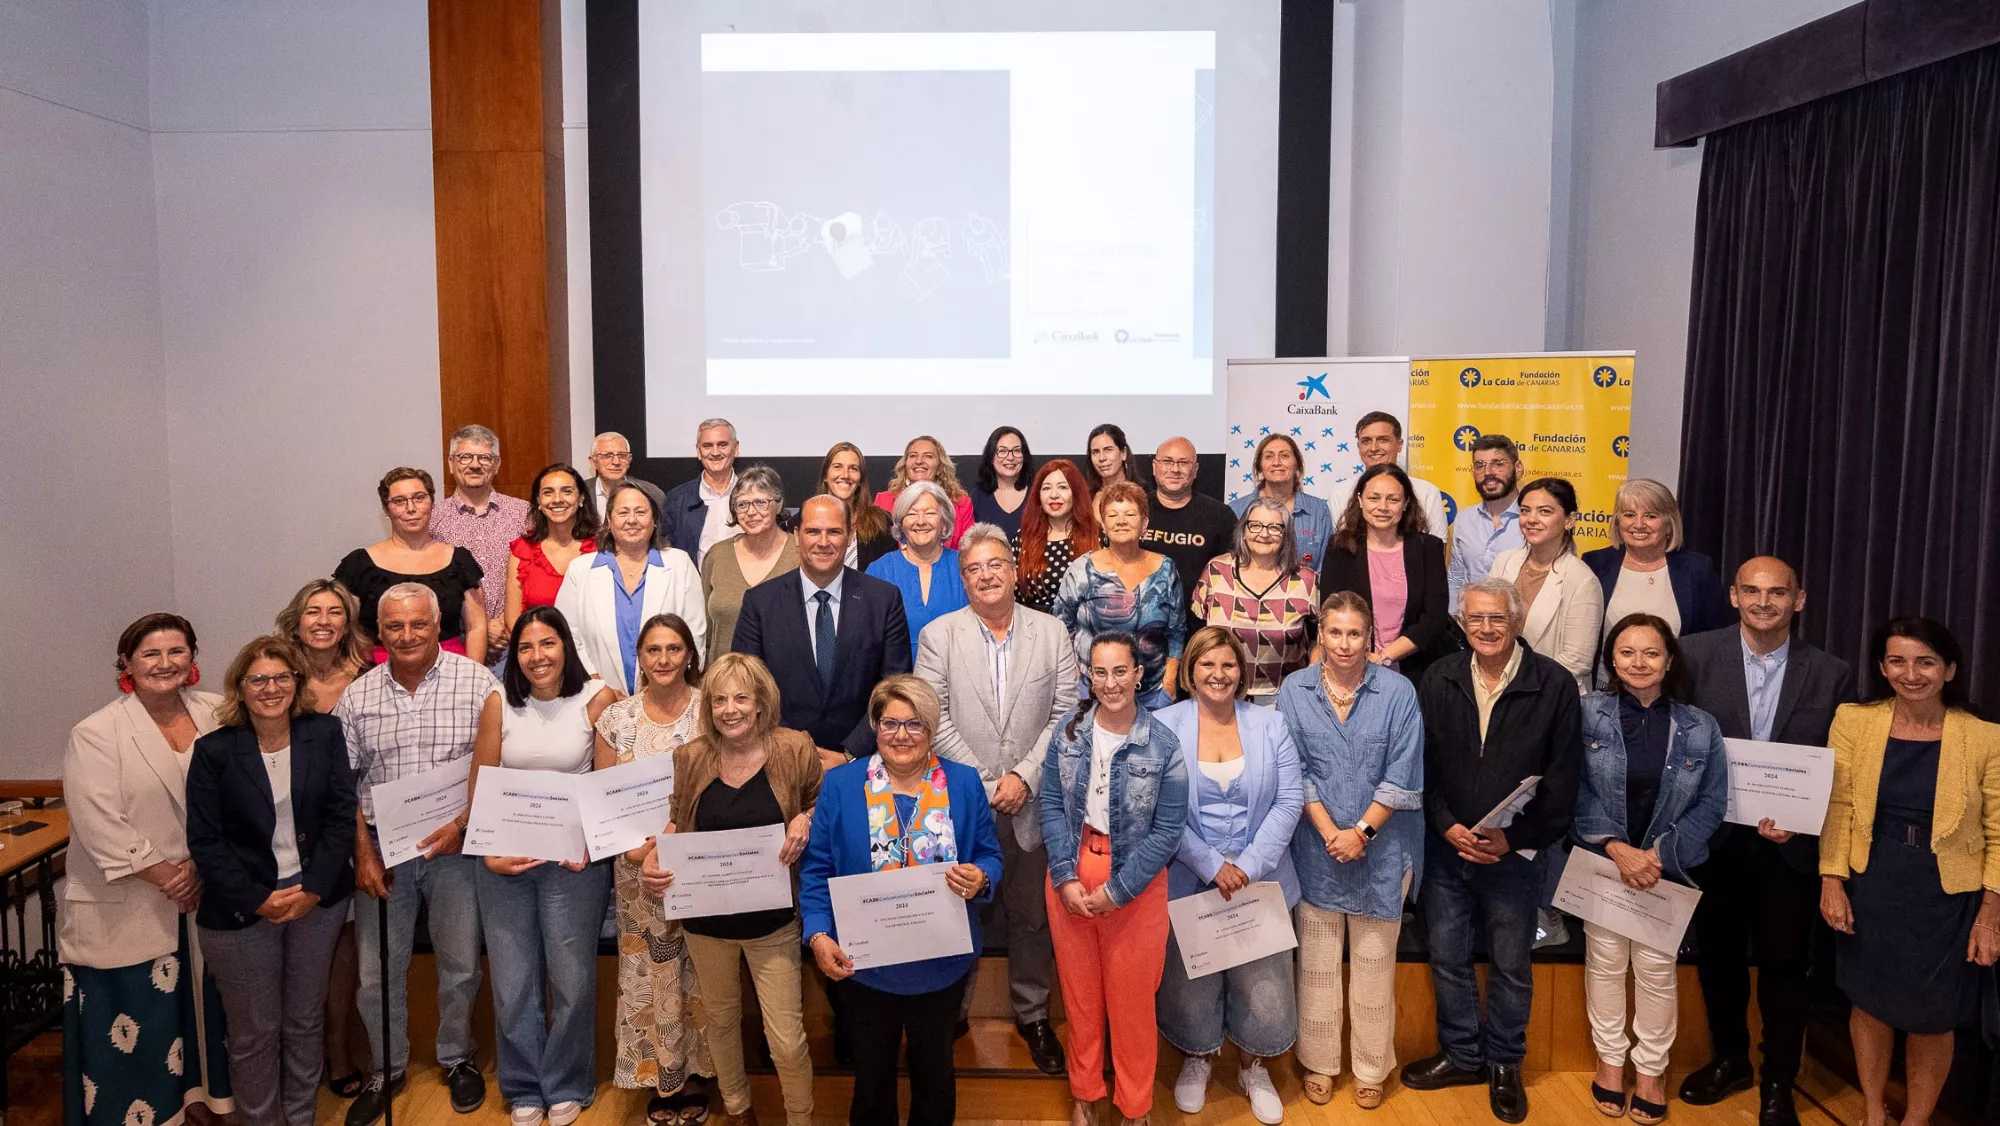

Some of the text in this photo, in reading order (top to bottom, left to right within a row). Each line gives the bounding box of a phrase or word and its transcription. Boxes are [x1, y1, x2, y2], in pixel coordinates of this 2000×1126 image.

[1520, 369, 1559, 379] Fundación
[1482, 378, 1559, 387] La Caja de CANARIAS
[1618, 377, 1631, 387] La
[1287, 403, 1339, 416] CaixaBank
[1533, 433, 1586, 443] Fundación
[1528, 444, 1539, 452] de
[1541, 444, 1586, 453] CANARIAS
[1139, 528, 1206, 547] EFUGIO
